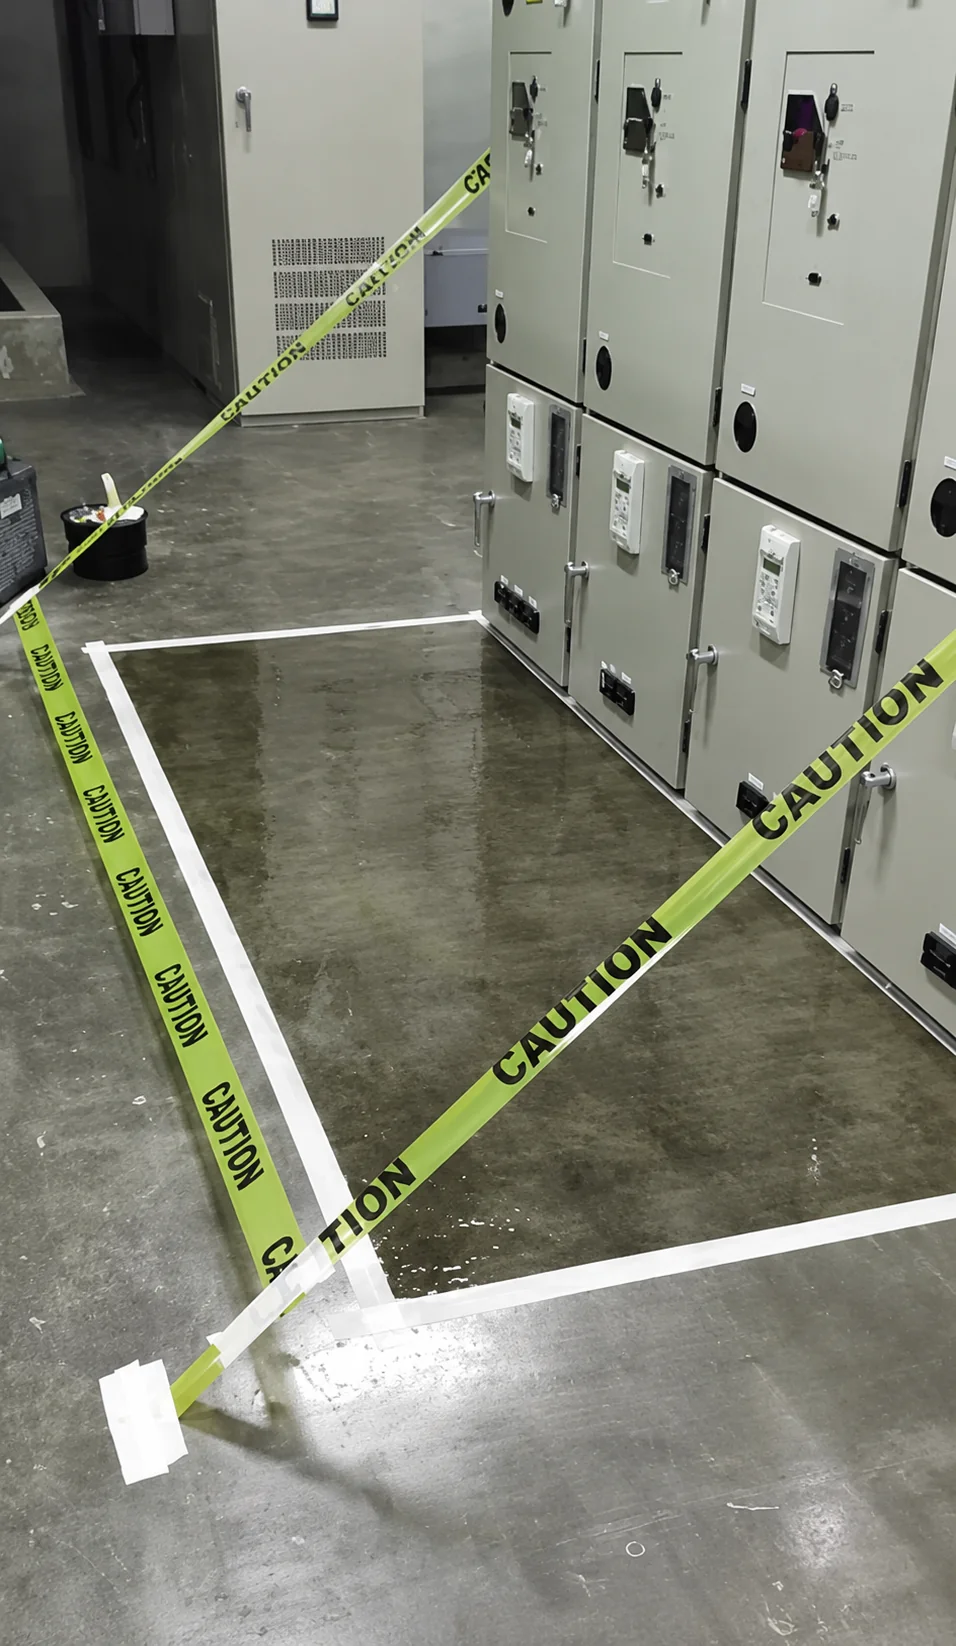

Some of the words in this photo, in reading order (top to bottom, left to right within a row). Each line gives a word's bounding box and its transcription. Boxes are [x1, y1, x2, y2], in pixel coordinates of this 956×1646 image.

[220, 341, 307, 422] CAUTION
[30, 644, 64, 692] CAUTION
[55, 711, 93, 764] CAUTION
[83, 785, 125, 843] CAUTION
[116, 867, 164, 937] CAUTION
[154, 963, 209, 1049] CAUTION
[202, 1081, 265, 1191] CAUTION
[317, 1157, 418, 1255] TION
[492, 916, 673, 1085] CAUTION
[752, 658, 945, 840] CAUTION
